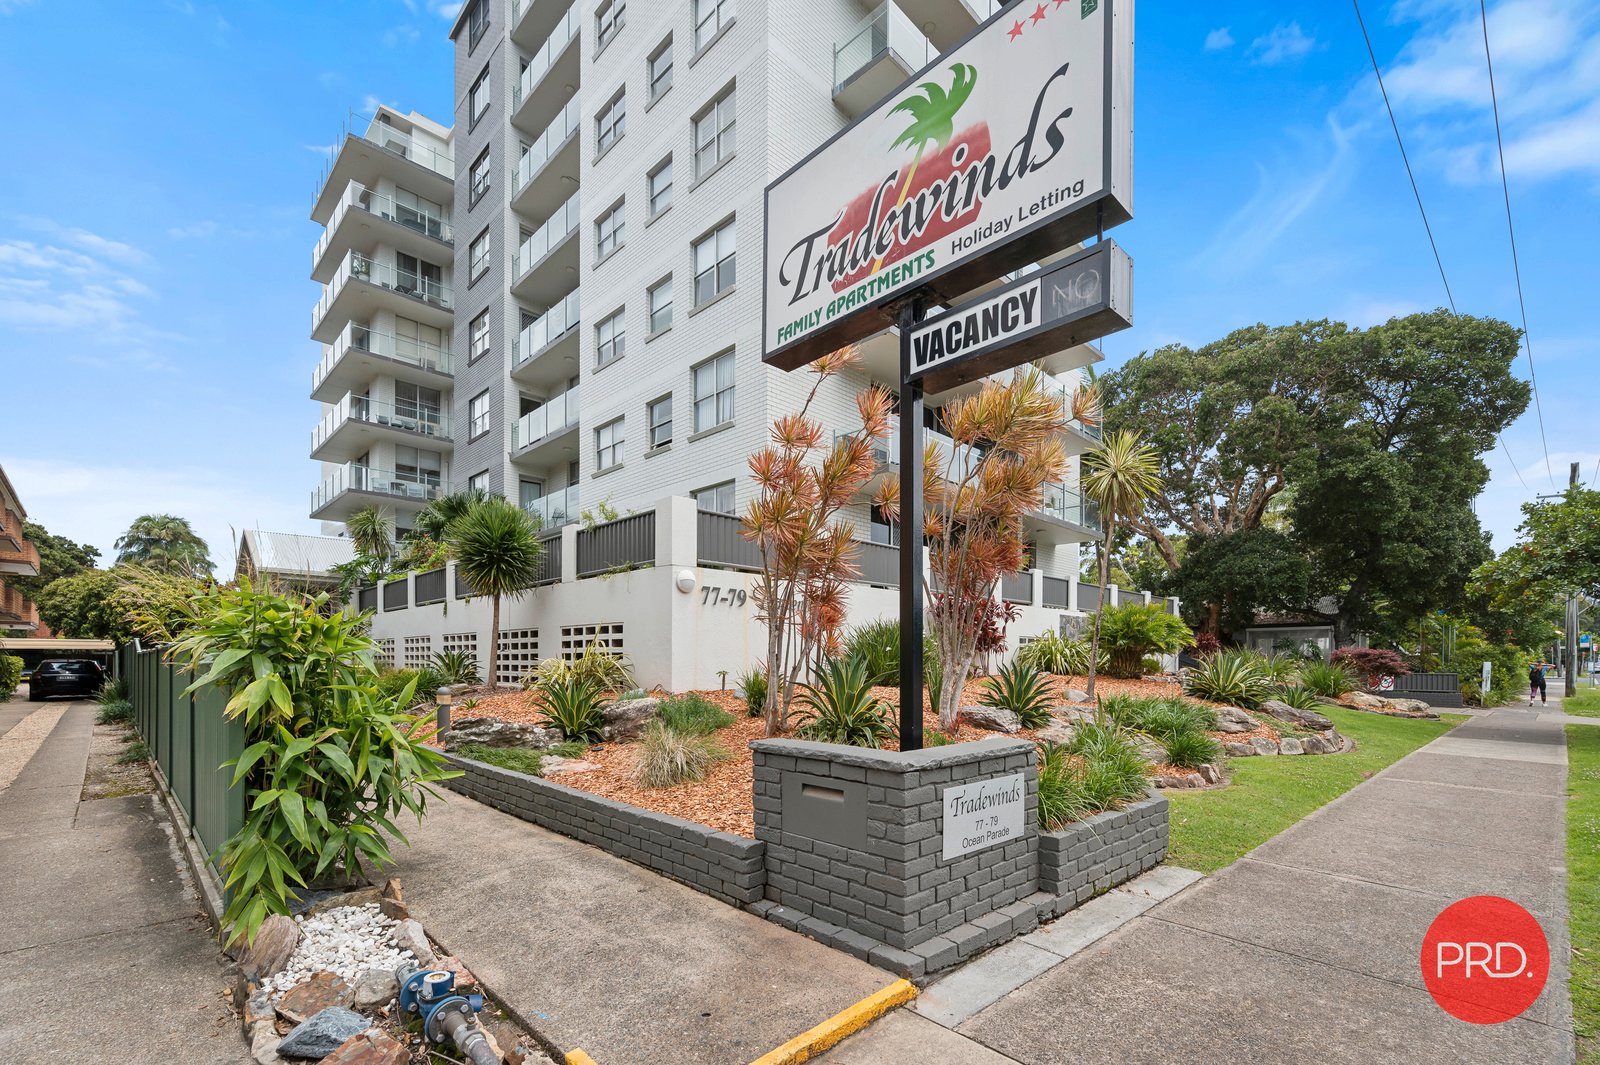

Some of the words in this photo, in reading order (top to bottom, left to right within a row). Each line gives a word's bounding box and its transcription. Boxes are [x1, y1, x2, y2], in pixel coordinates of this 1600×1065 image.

[778, 62, 1073, 306] Tradewinds
[951, 211, 1013, 255] Holiday
[1019, 179, 1085, 221] Letting
[777, 306, 823, 346] FAMILY
[826, 249, 936, 317] APARTMENTS
[913, 286, 1039, 367] VACANCY
[701, 586, 747, 607] 77-79
[950, 778, 1020, 817] Tradewinds
[975, 819, 984, 831] 77
[989, 815, 999, 827] 79
[962, 834, 985, 848] Ocean
[987, 826, 1010, 841] Parade
